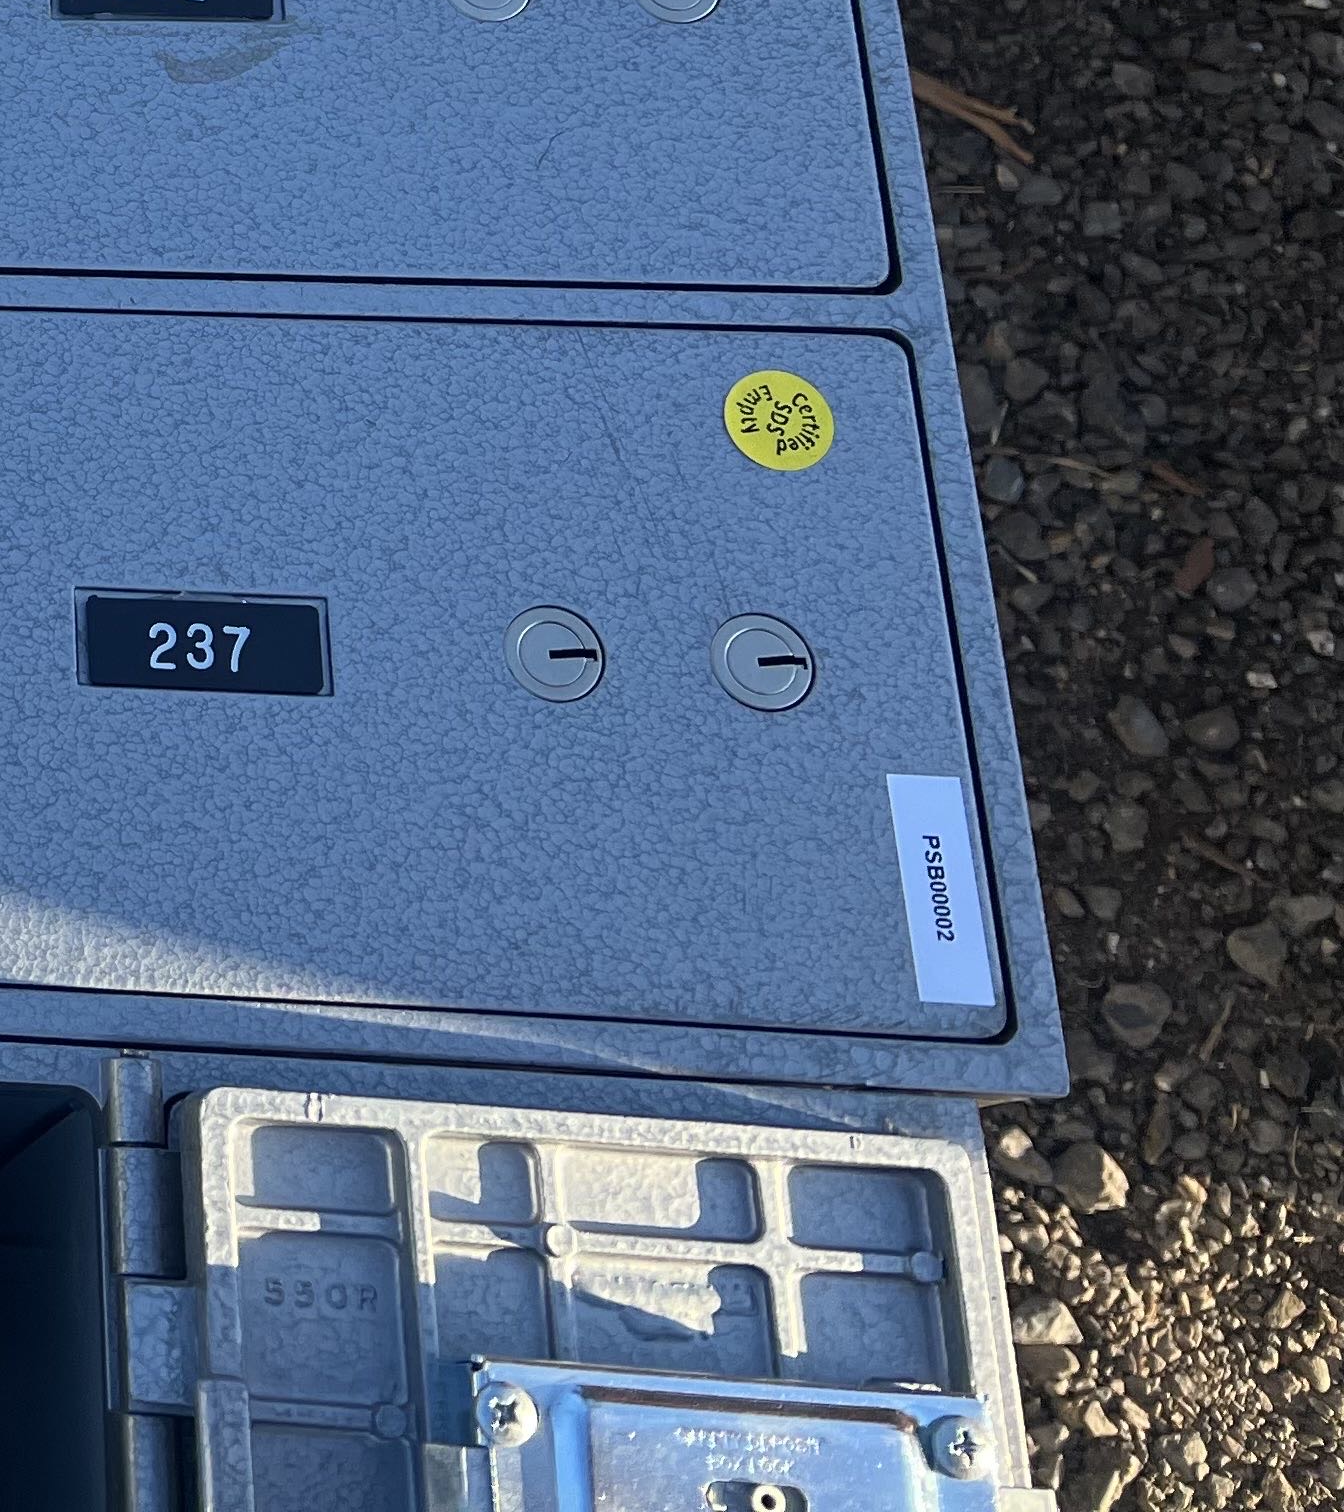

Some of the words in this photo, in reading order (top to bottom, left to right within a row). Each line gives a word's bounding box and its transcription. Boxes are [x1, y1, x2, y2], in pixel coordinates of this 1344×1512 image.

[736, 385, 772, 433] Empty
[766, 401, 792, 436] SDS
[776, 393, 820, 455] Certified
[147, 622, 250, 673] 237
[922, 835, 955, 943] PSB00002
